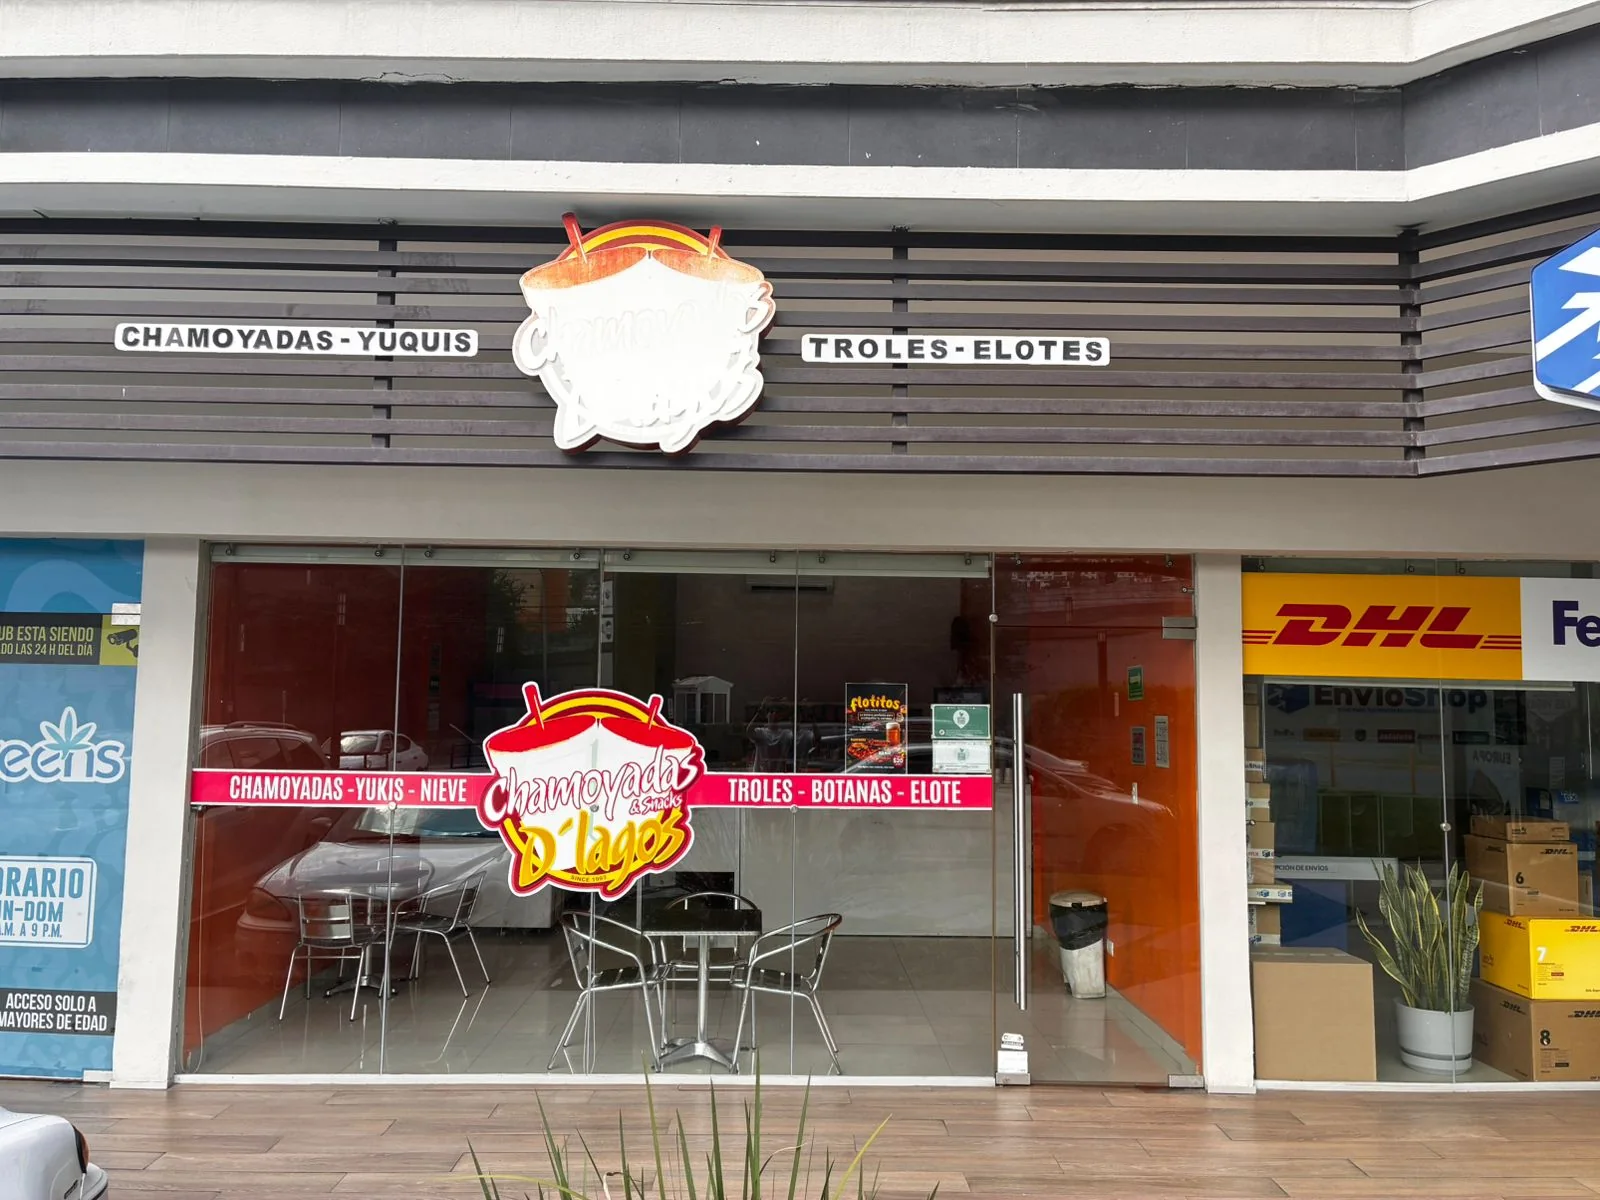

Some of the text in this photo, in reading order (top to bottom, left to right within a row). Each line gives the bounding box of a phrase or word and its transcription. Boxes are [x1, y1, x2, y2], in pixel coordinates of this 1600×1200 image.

[122, 326, 334, 351] CHAMOYADAS
[357, 331, 471, 353] YUQUIS
[809, 337, 948, 360] TROLES
[973, 339, 1103, 361] ELOTES
[17, 625, 46, 641] ESTA
[49, 626, 94, 642] SIENDO
[1272, 603, 1485, 649] DHL
[1552, 600, 1600, 647] Fe
[15, 643, 33, 655] LAS
[34, 643, 47, 655] 24
[49, 643, 56, 655] H
[58, 643, 75, 656] DEL
[77, 642, 93, 656] DÍA
[229, 775, 343, 800] CHAMOYADAS
[420, 778, 467, 802] NIEVE
[483, 744, 699, 822] Chamoyadas
[728, 778, 793, 803] TROLES
[811, 779, 892, 804] BOTANAS
[911, 780, 961, 804] ELOTE
[641, 791, 683, 815] Snacks
[0, 866, 84, 899] RARIO
[570, 874, 589, 882] SINCE
[1515, 871, 1525, 884] 6
[0, 900, 64, 922] N-DOM
[20, 922, 27, 936] A
[31, 922, 38, 937] 9
[42, 923, 63, 937] P.M.
[1536, 946, 1547, 963] 7
[5, 992, 97, 1012] ACCESO SOLO A
[0, 1011, 108, 1031] MAYORES DE EDAD
[1539, 1029, 1551, 1046] 8
